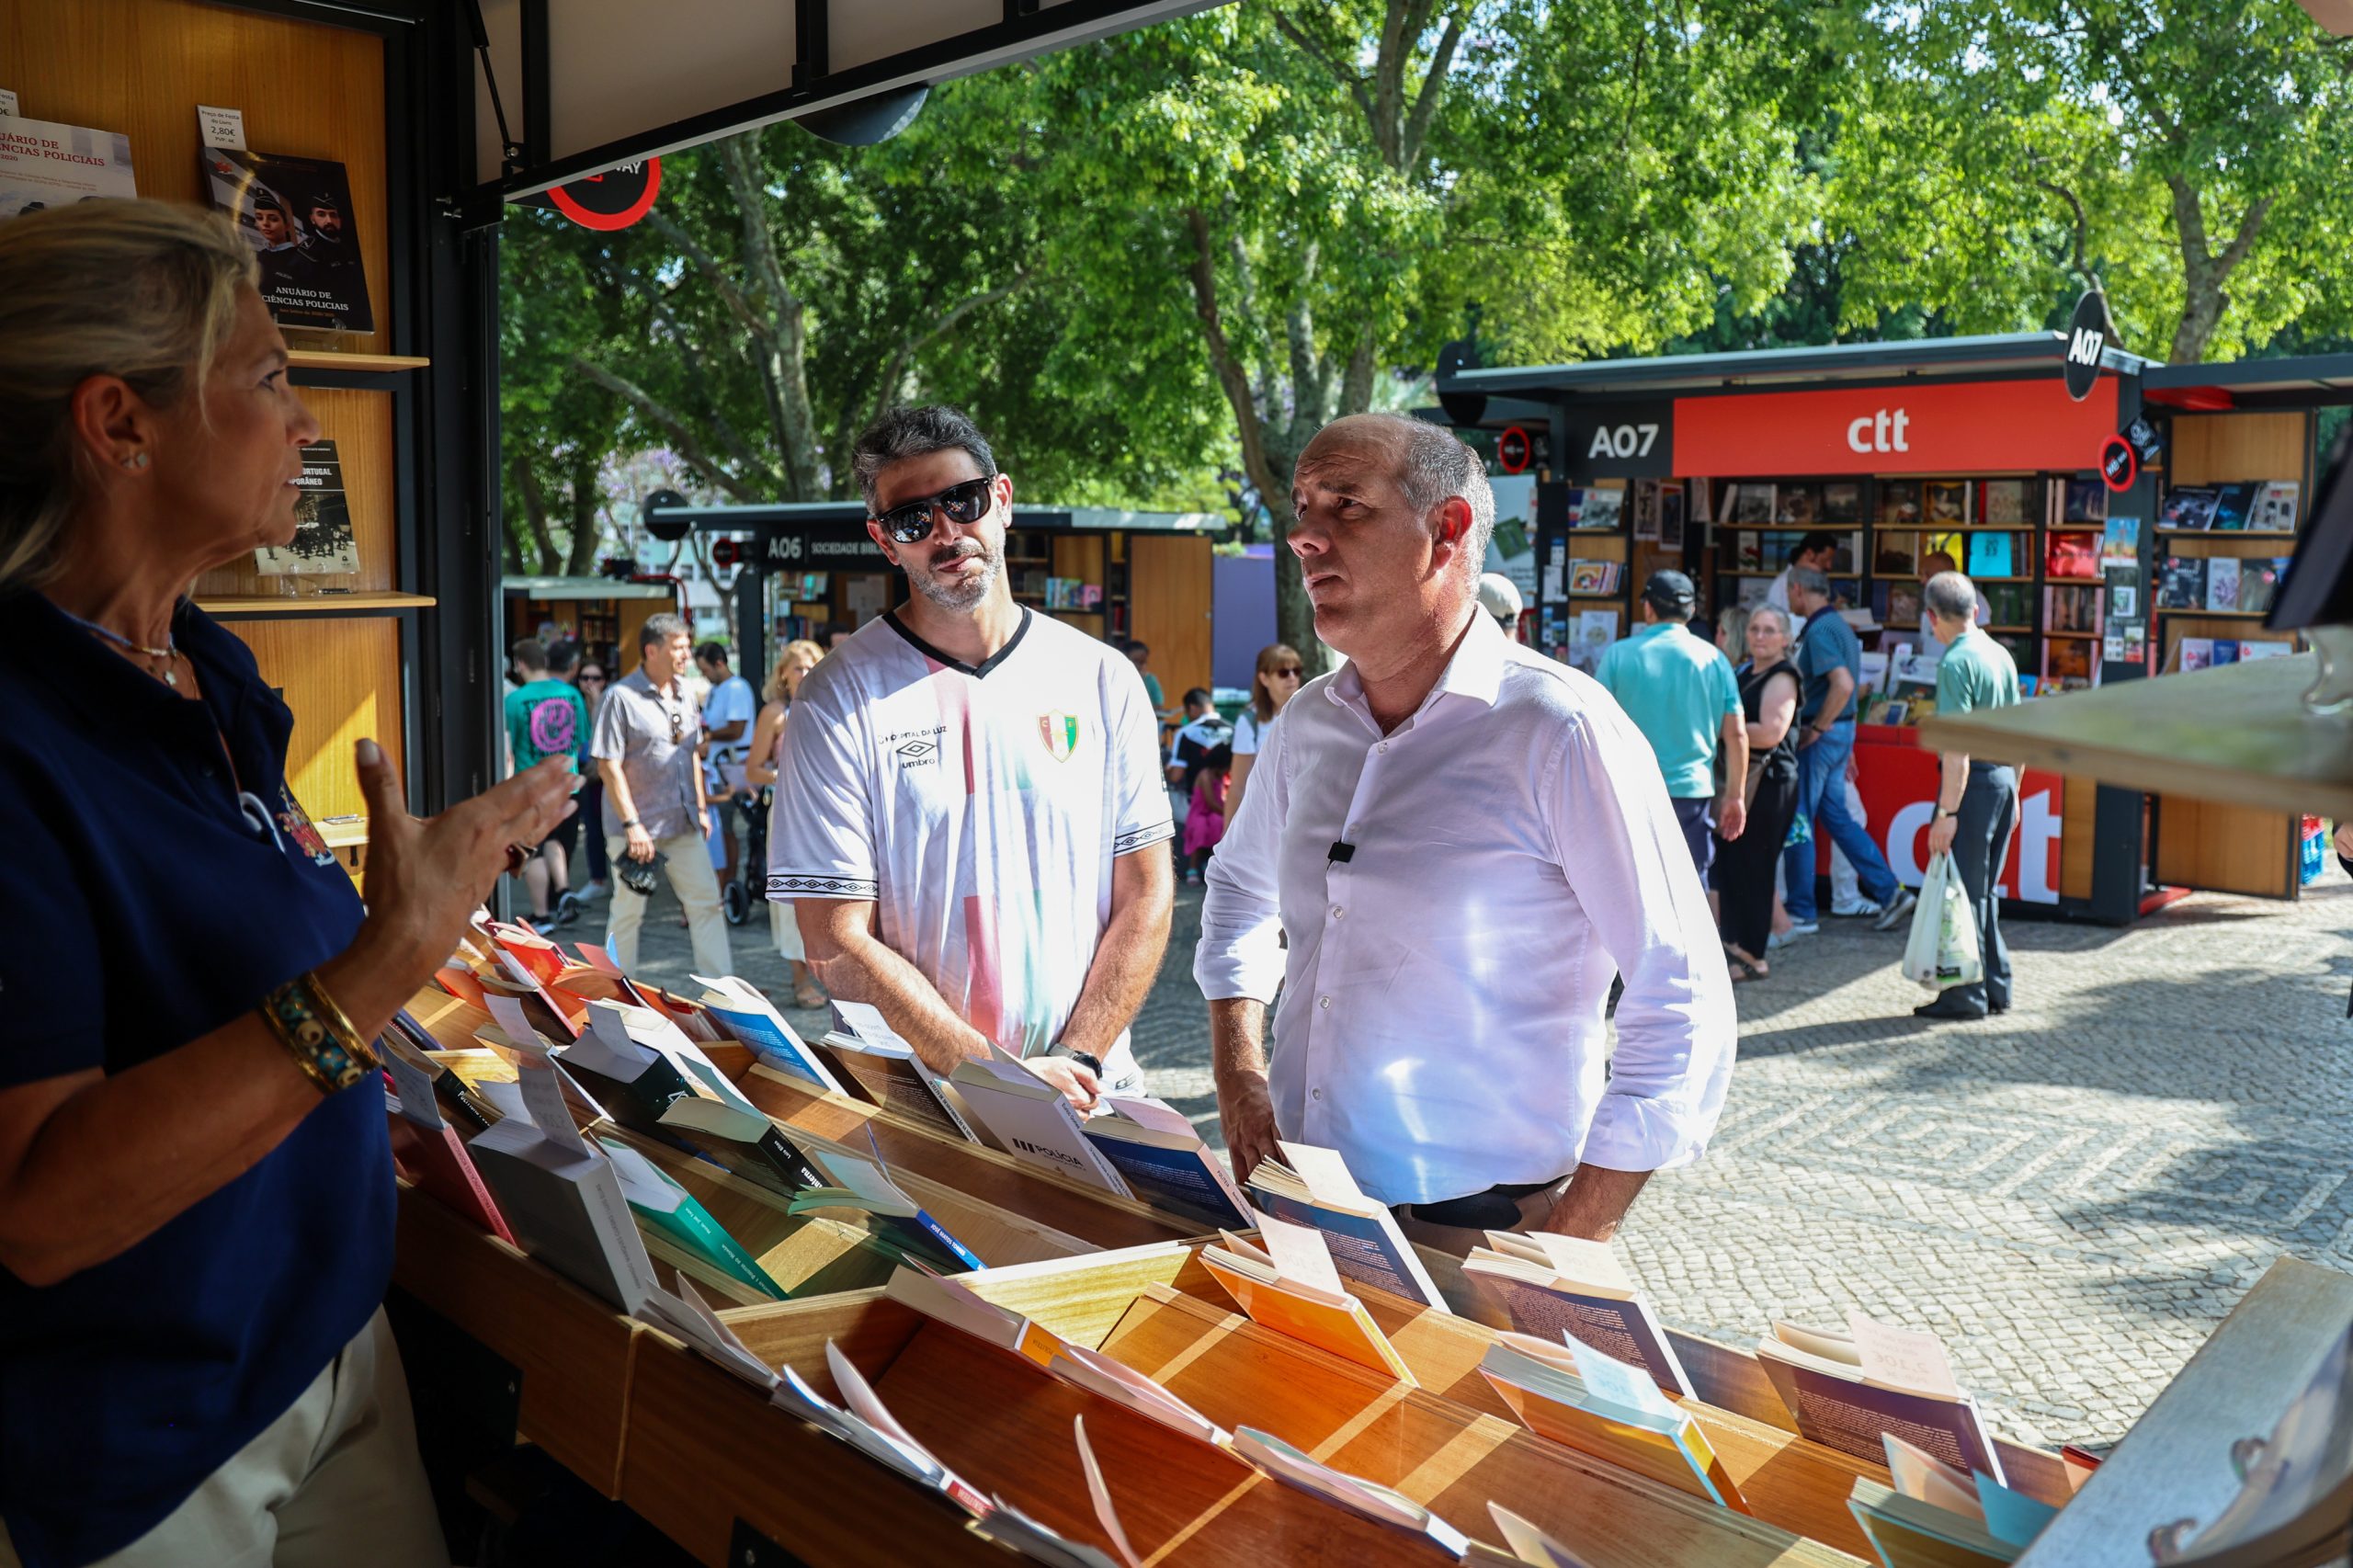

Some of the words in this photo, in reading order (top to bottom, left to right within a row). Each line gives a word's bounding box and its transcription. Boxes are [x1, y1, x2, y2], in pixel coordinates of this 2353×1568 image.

[210, 126, 236, 137] 2,80€
[41, 139, 59, 150] DE
[0, 143, 40, 157] NCIAS
[43, 150, 105, 166] POLICIAIS
[276, 286, 317, 298] ANUÁRIO
[318, 291, 332, 300] DE
[261, 294, 304, 307] CIÊNCIAS
[305, 300, 349, 311] POLICIAIS
[2068, 326, 2104, 366] A07
[1847, 408, 1909, 453] ctt
[1588, 425, 1659, 459] A07
[301, 467, 332, 476] ORTUGAL
[767, 536, 802, 559] A06
[811, 541, 858, 555] SOCIEDADE
[885, 732, 920, 743] HOPITAL
[933, 725, 948, 735] LUZ
[902, 758, 936, 768] umbro
[1034, 1143, 1085, 1168] POLÍCIA
[1217, 1170, 1230, 1187] POLITEIA
[930, 1223, 941, 1234] JOSÉ
[939, 1231, 953, 1245] MATOS
